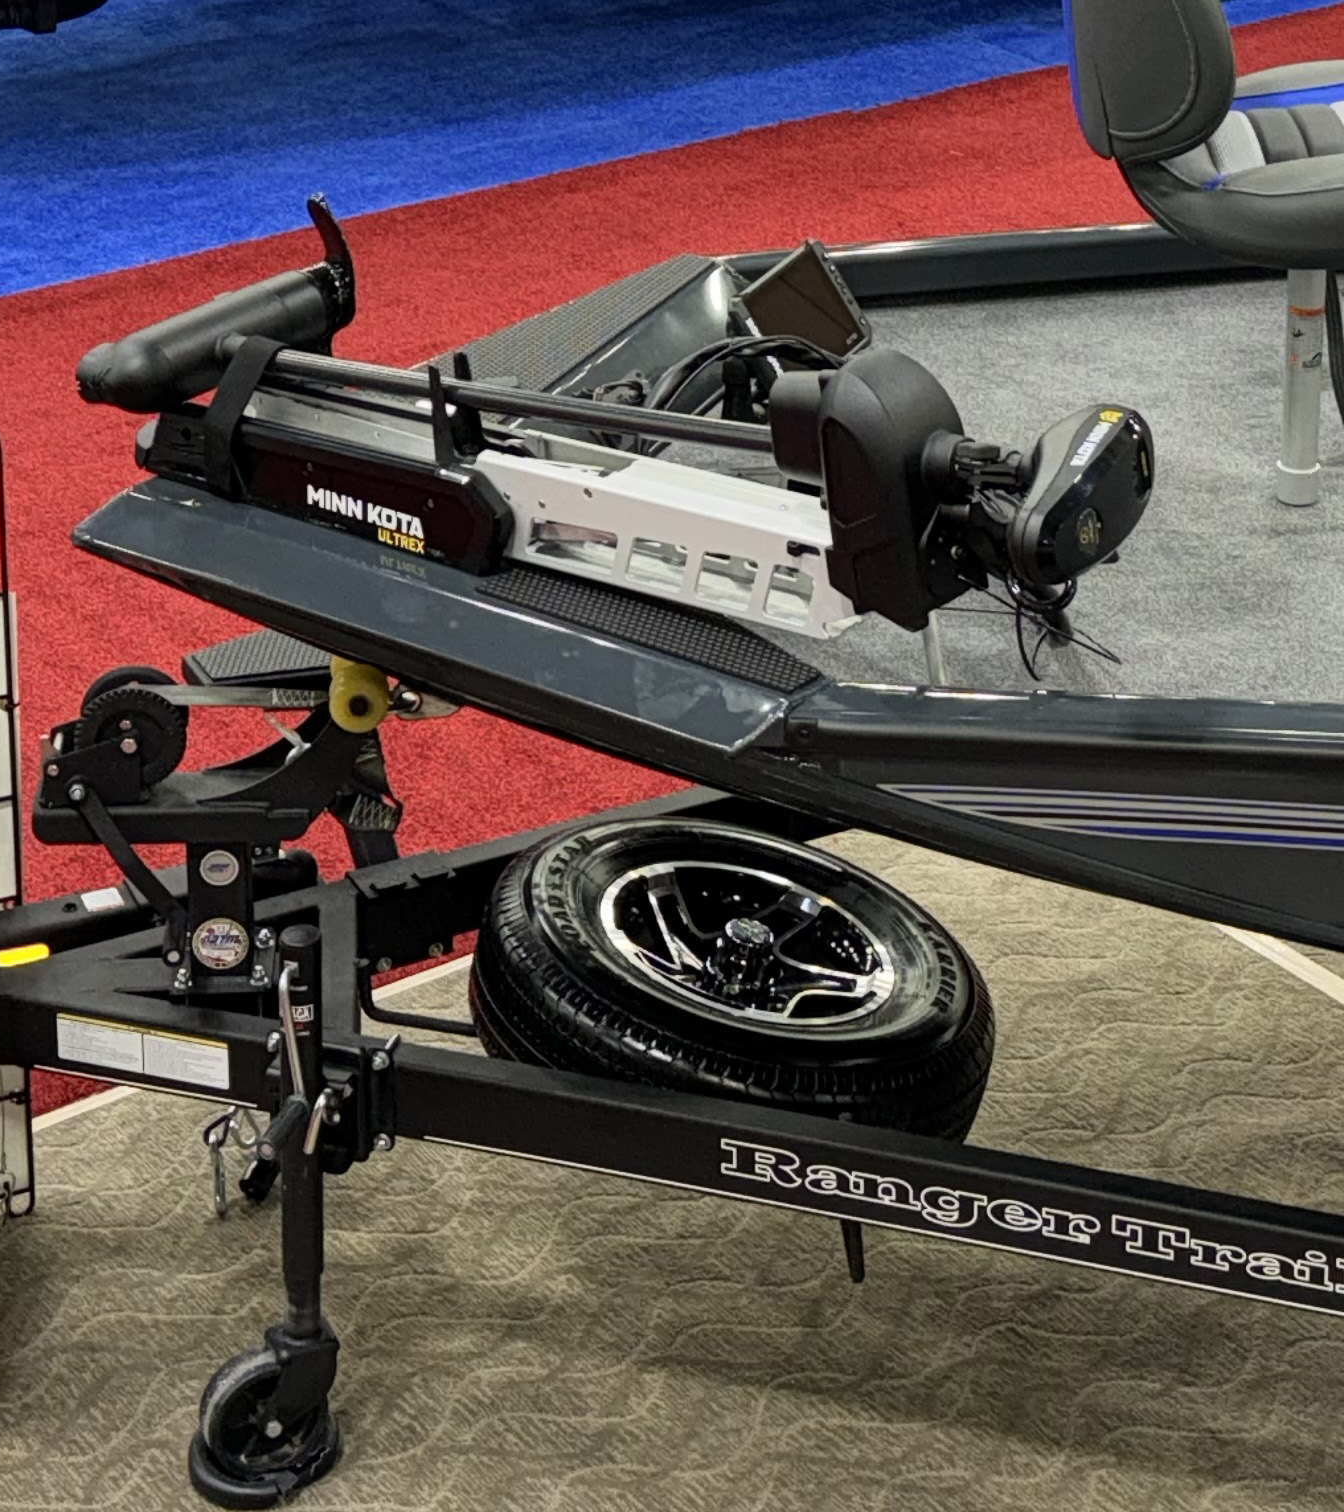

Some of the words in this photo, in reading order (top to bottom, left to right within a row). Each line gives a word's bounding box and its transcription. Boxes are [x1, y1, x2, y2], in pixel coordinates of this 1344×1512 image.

[305, 483, 364, 523] MINN
[365, 501, 425, 540] KOTA
[376, 526, 426, 555] ULTREX
[718, 1136, 1102, 1245] Ranger
